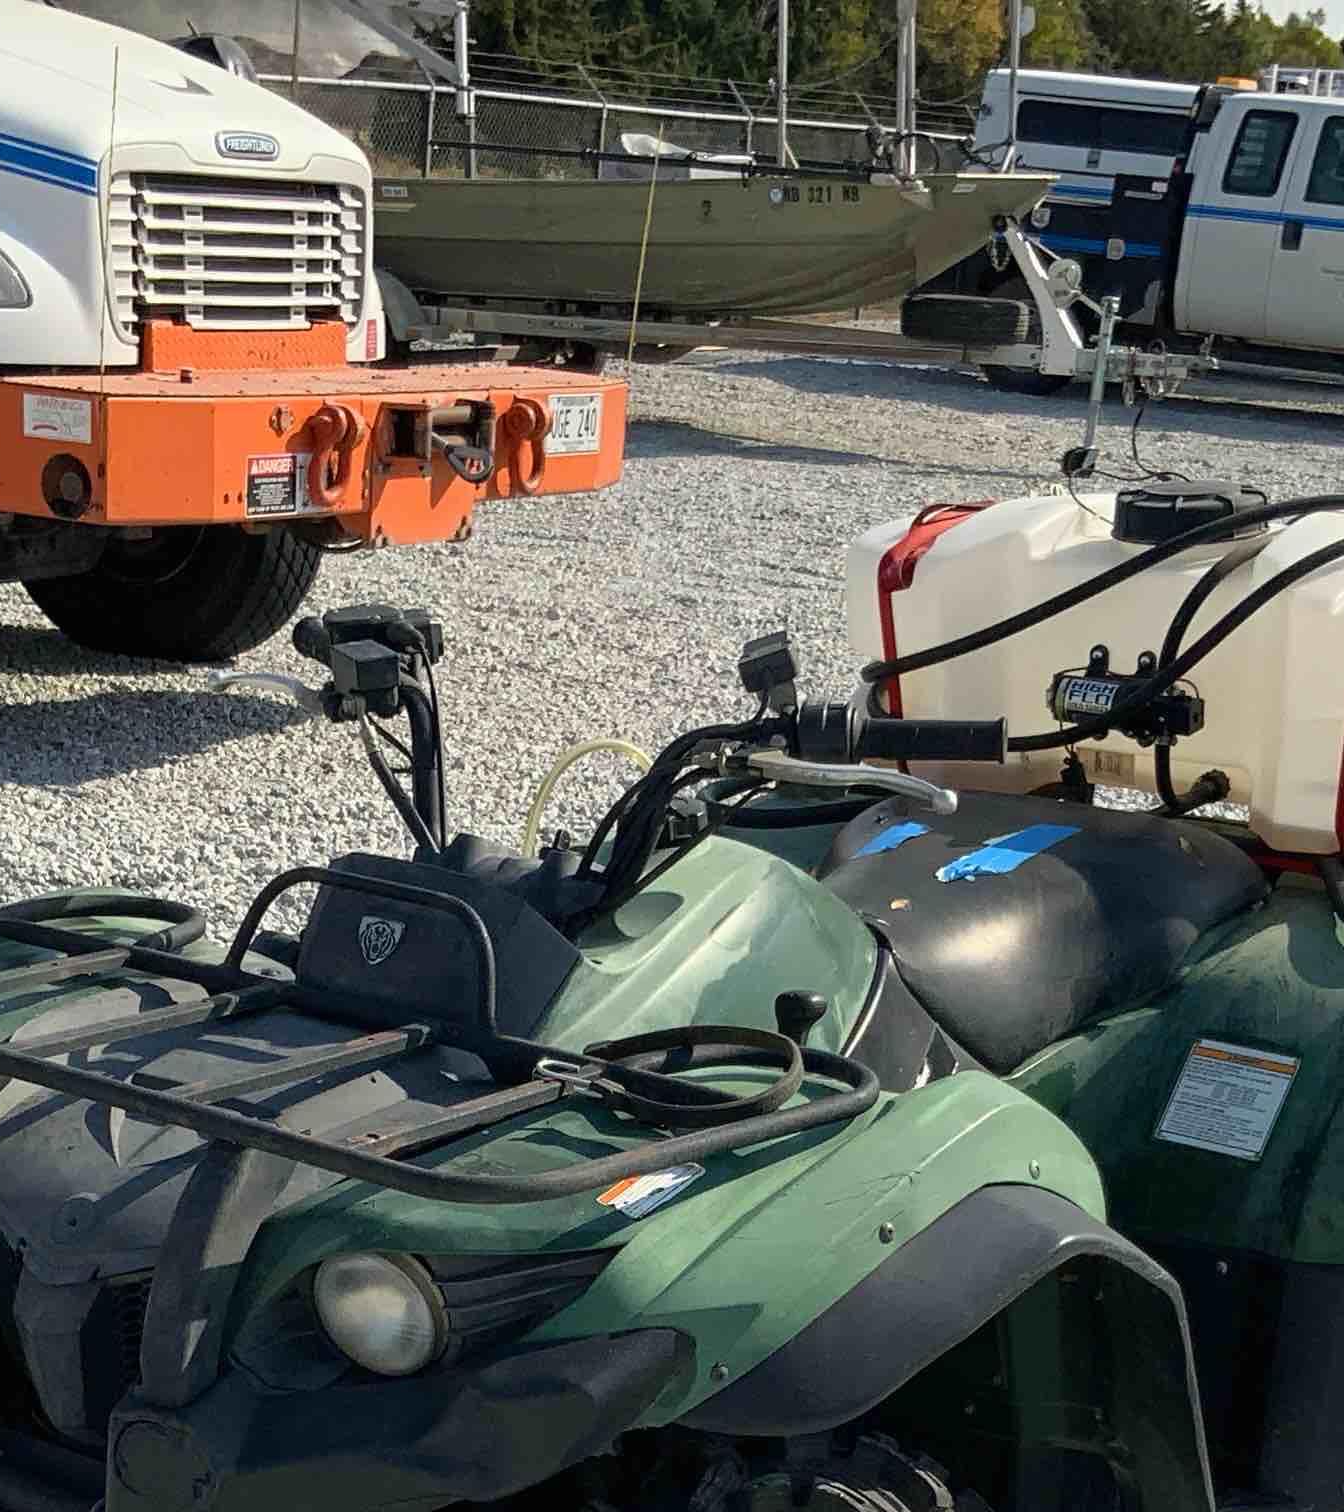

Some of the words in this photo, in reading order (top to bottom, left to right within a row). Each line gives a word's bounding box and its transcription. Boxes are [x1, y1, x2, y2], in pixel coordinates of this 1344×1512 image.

[226, 138, 273, 153] FREIGHTLINER
[259, 457, 294, 474] DANGER
[1072, 680, 1114, 695] HIGH
[1069, 690, 1112, 706] FLO
